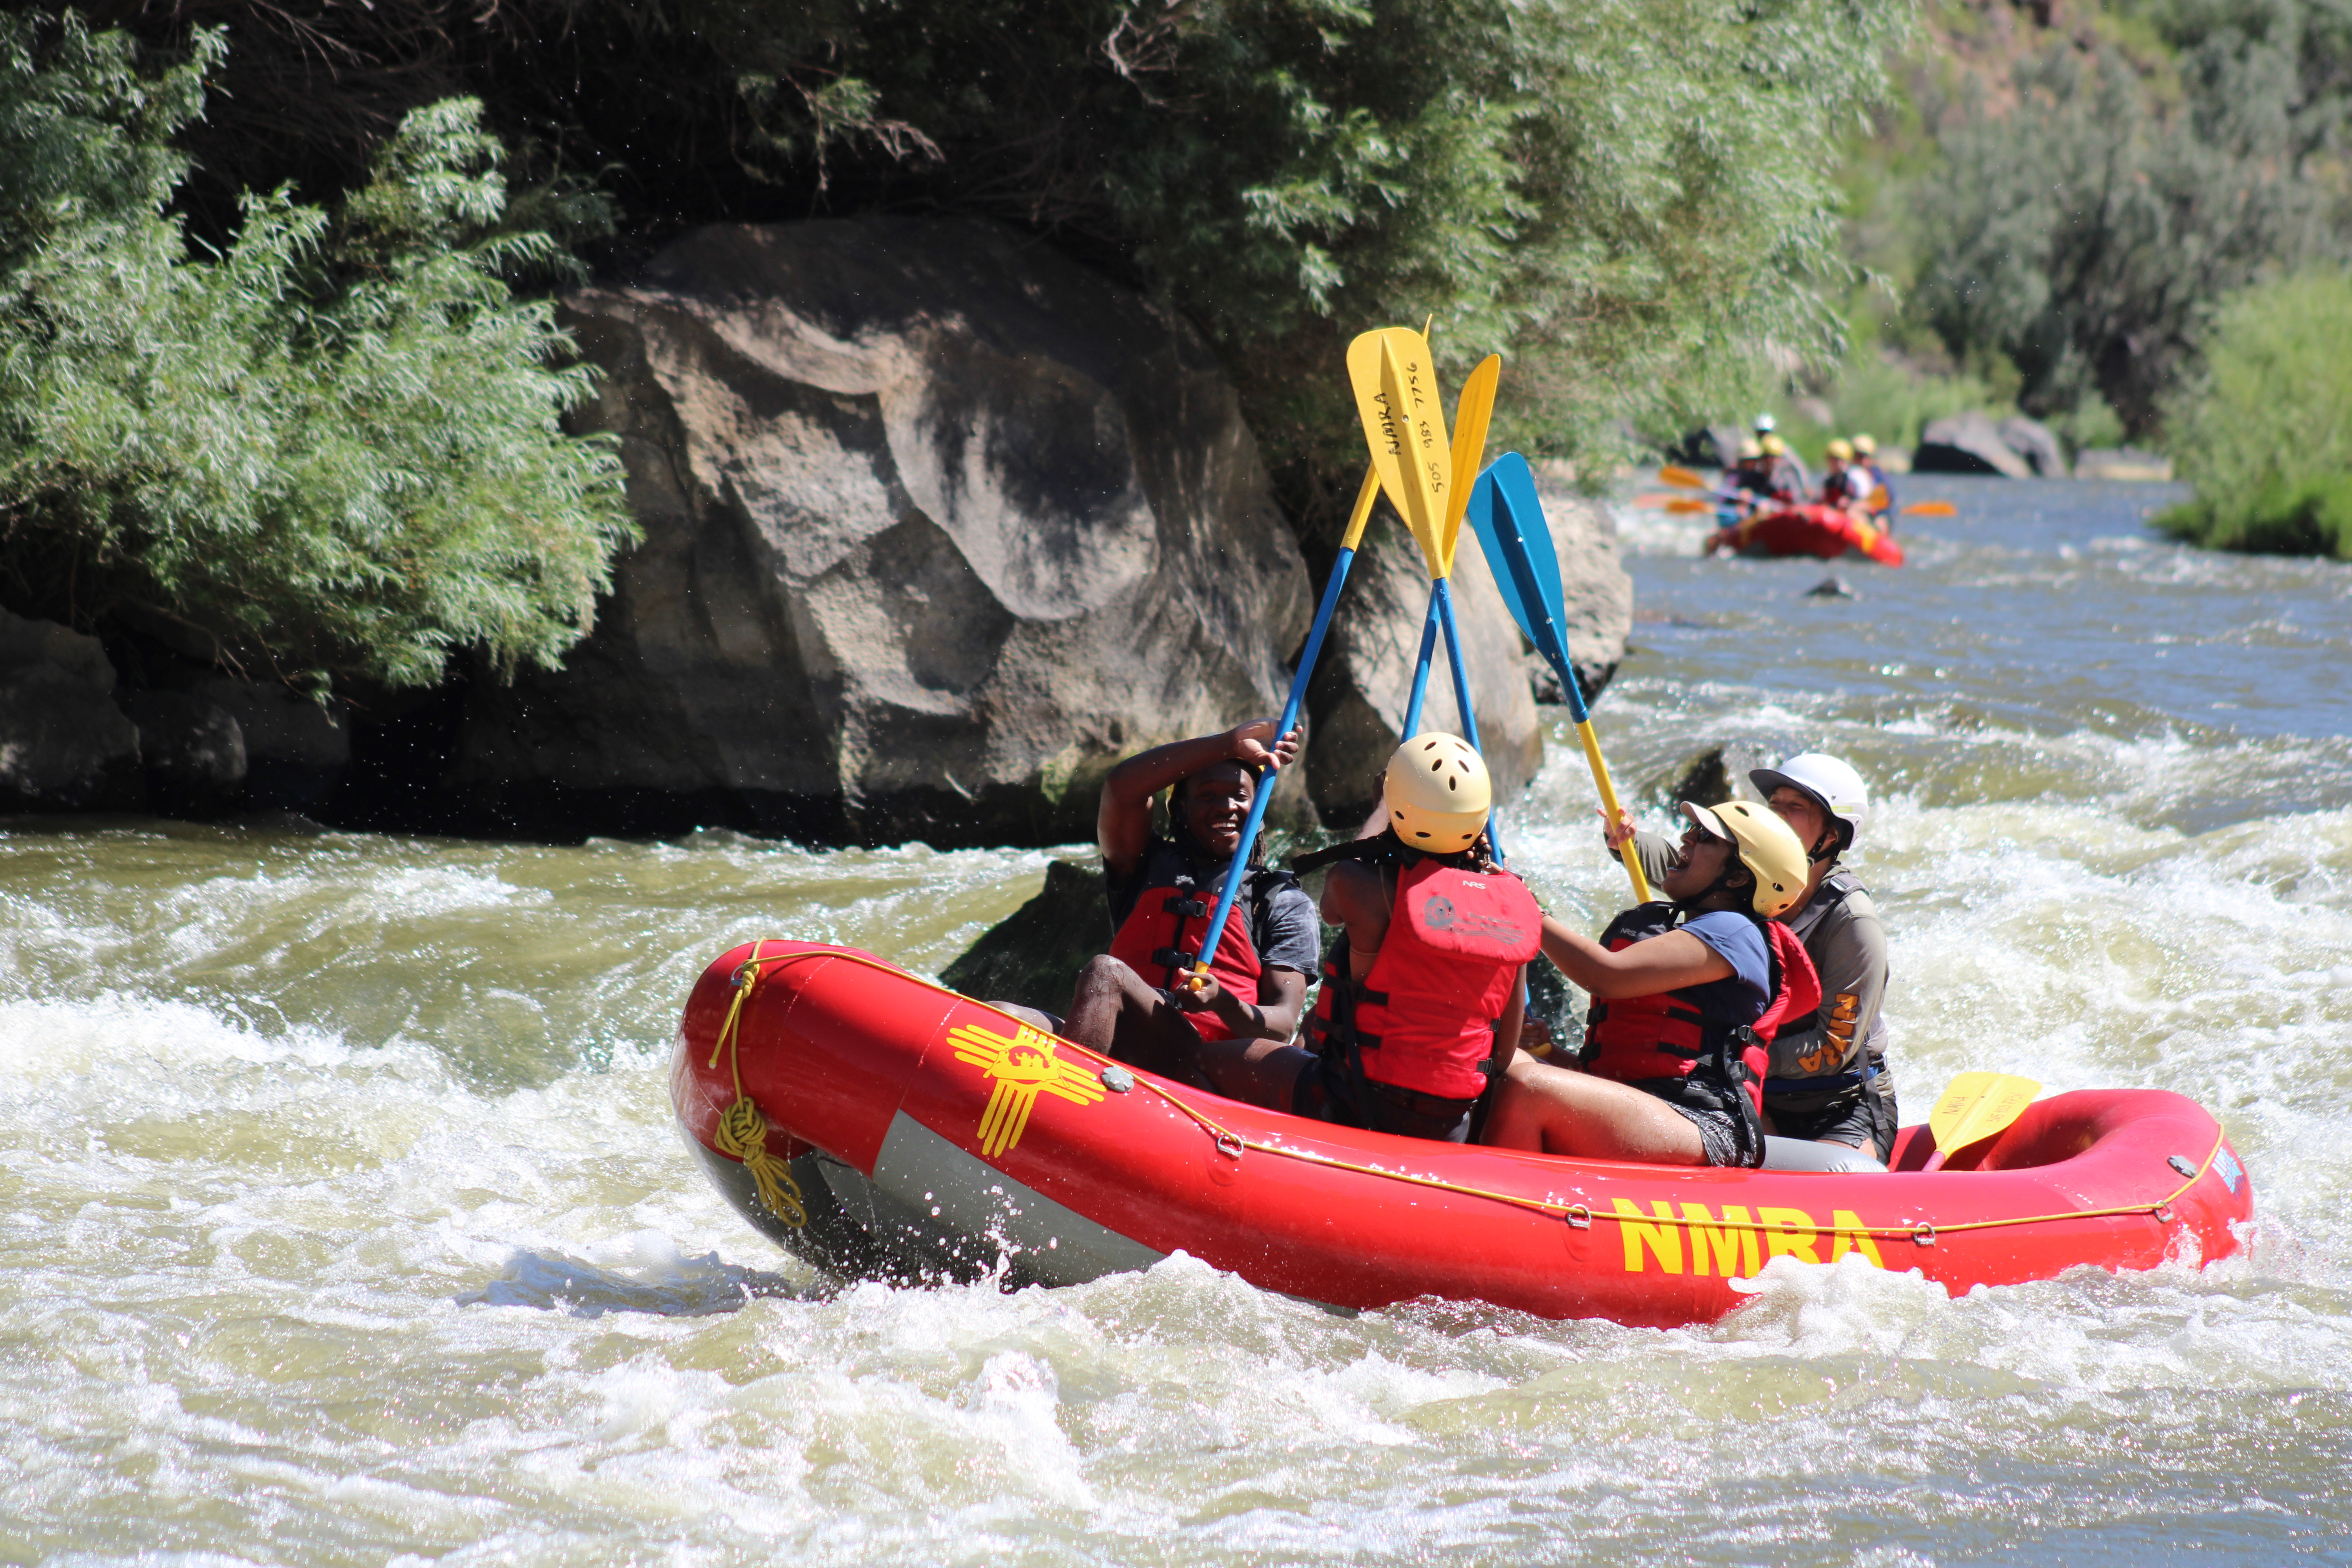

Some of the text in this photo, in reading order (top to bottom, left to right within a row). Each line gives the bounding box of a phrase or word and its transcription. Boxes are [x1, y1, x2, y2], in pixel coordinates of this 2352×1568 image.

[1374, 392, 1401, 455] NMRA
[1406, 362, 1445, 493] 505 983 7756
[1463, 880, 1486, 889] NRS
[1620, 928, 1637, 936] NRS
[1797, 993, 1859, 1073] NMRA
[1611, 1198, 1884, 1278] NMRA
